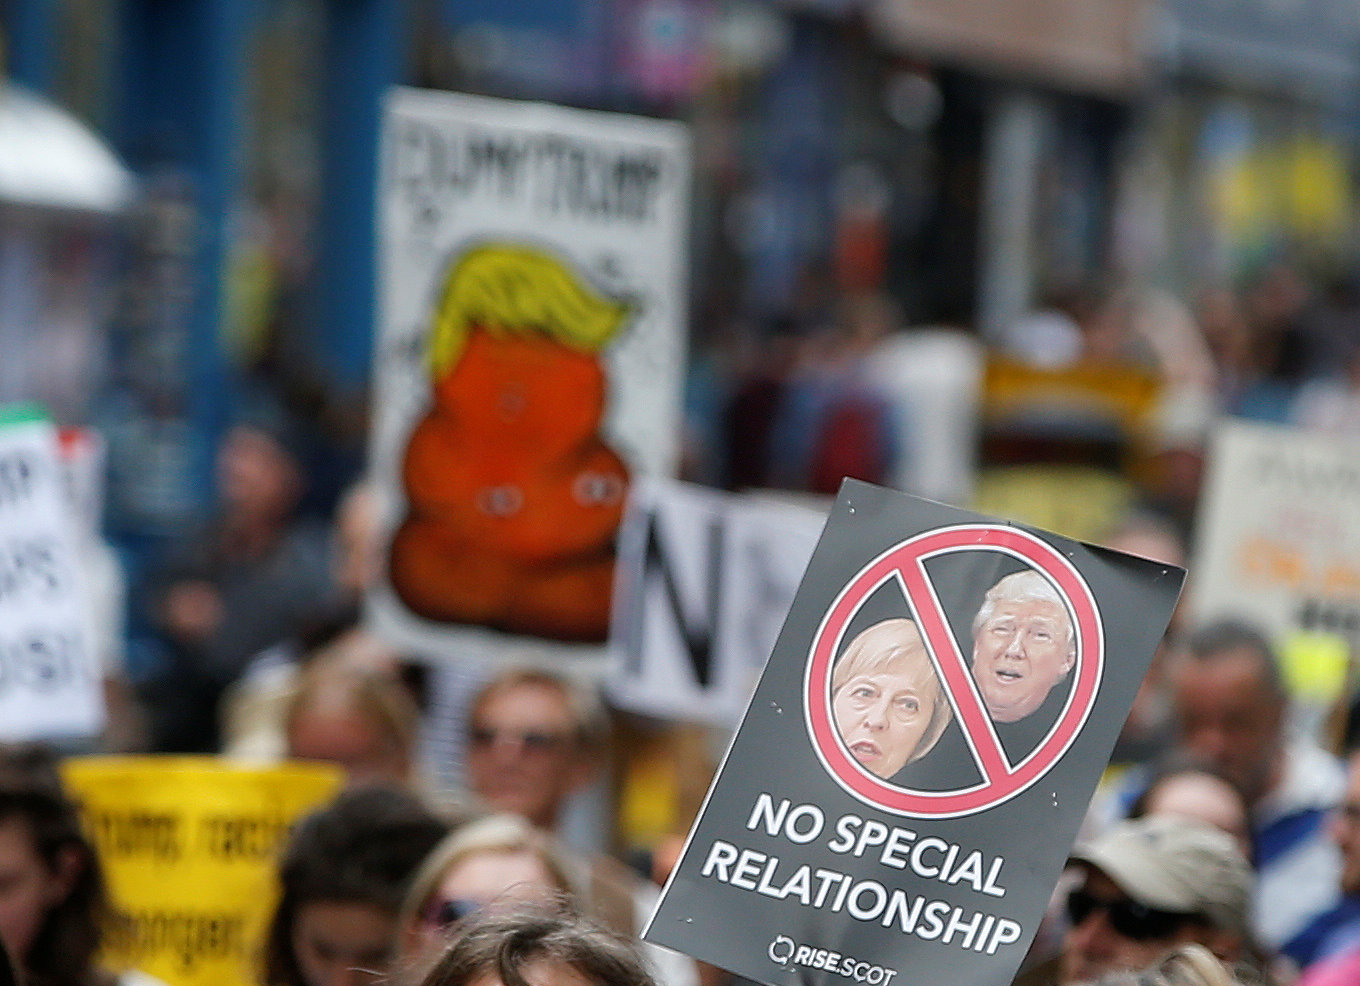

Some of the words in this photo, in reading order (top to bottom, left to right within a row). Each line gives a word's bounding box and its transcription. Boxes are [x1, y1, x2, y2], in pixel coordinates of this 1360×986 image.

[701, 840, 1023, 956] RELATIONSHIP
[745, 792, 826, 845] NO
[828, 814, 1006, 898] SPECIAL
